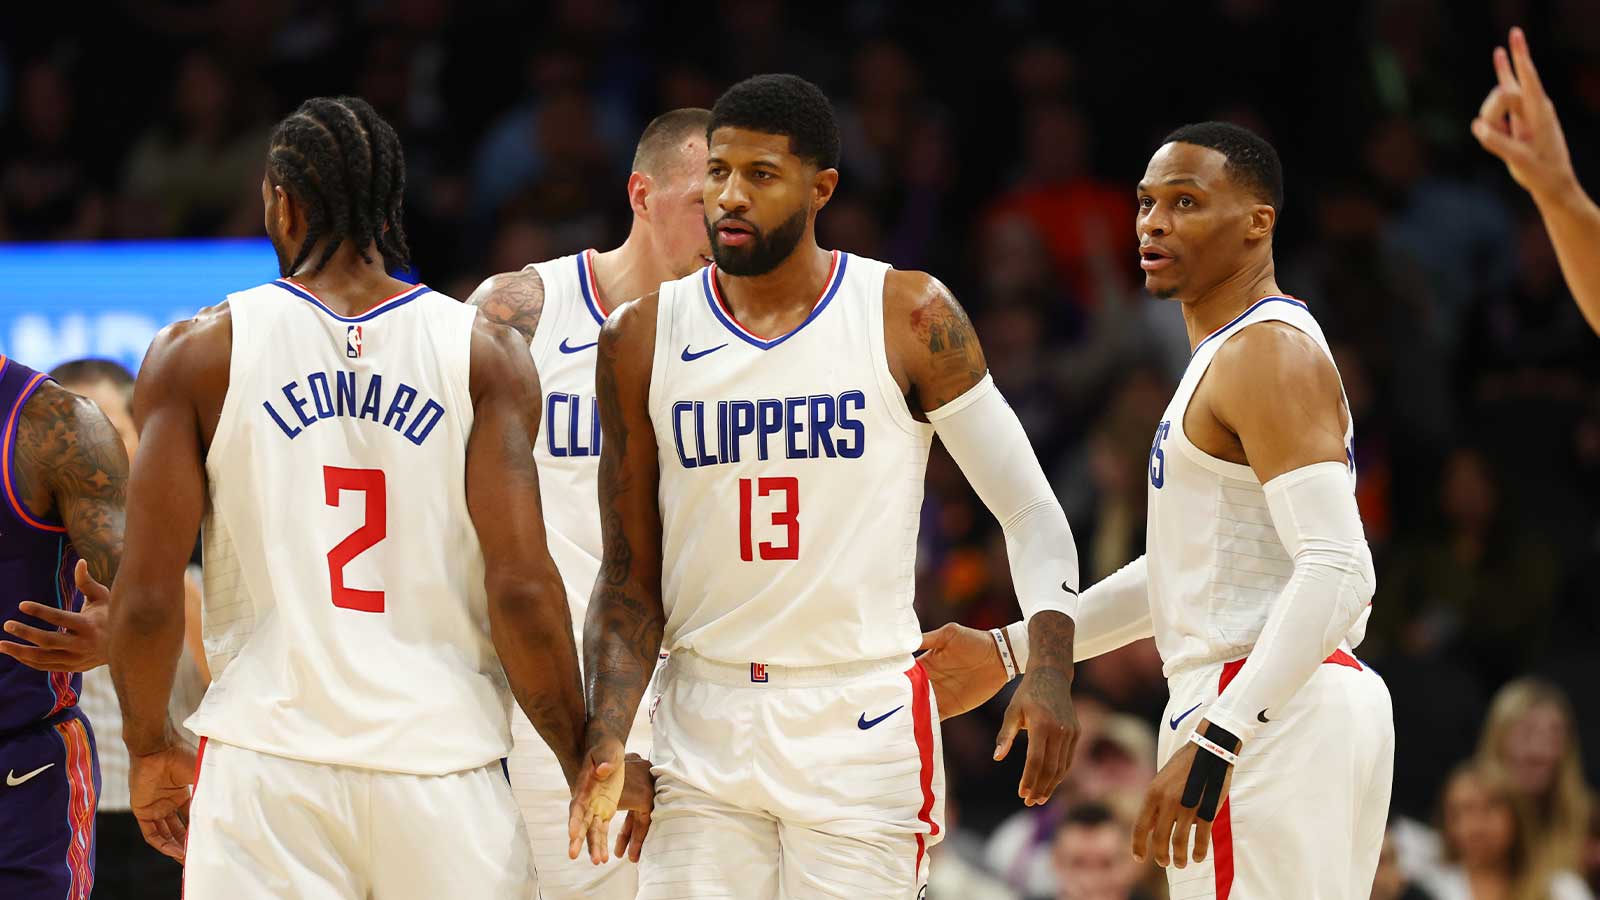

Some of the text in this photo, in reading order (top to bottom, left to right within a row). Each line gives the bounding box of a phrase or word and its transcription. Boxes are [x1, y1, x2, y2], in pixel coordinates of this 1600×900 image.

[263, 371, 445, 446] LEONARD
[671, 389, 866, 469] CLIPPERS
[323, 465, 386, 613] 2
[739, 476, 800, 562] 13
